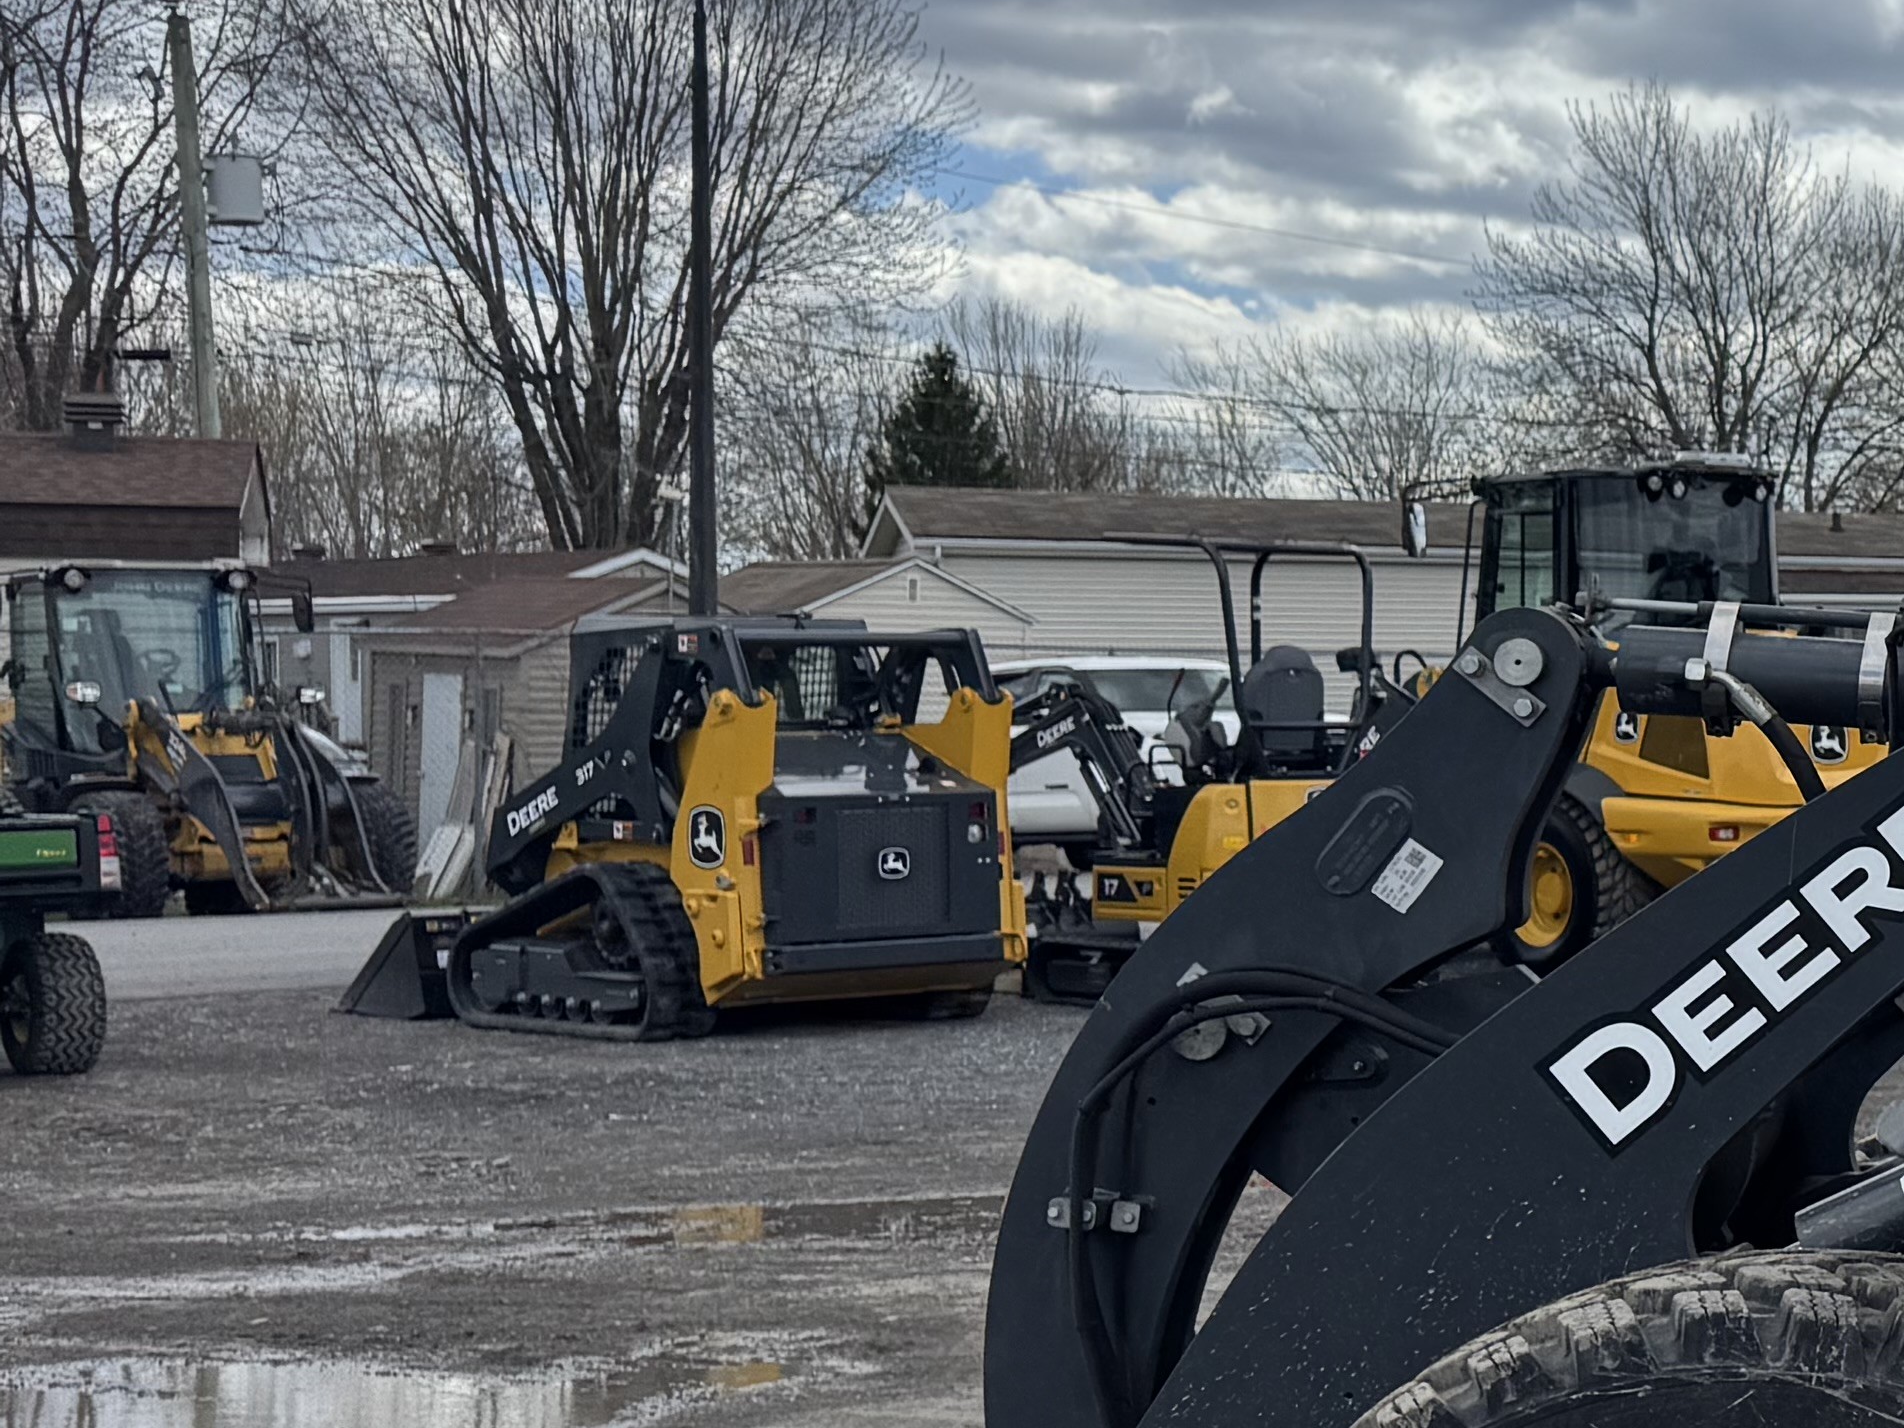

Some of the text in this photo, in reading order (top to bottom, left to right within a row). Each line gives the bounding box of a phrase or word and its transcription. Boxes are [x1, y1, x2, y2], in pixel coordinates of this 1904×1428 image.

[1037, 716, 1076, 748] DEERE
[507, 785, 559, 837] DEERE
[1103, 878, 1119, 896] 17
